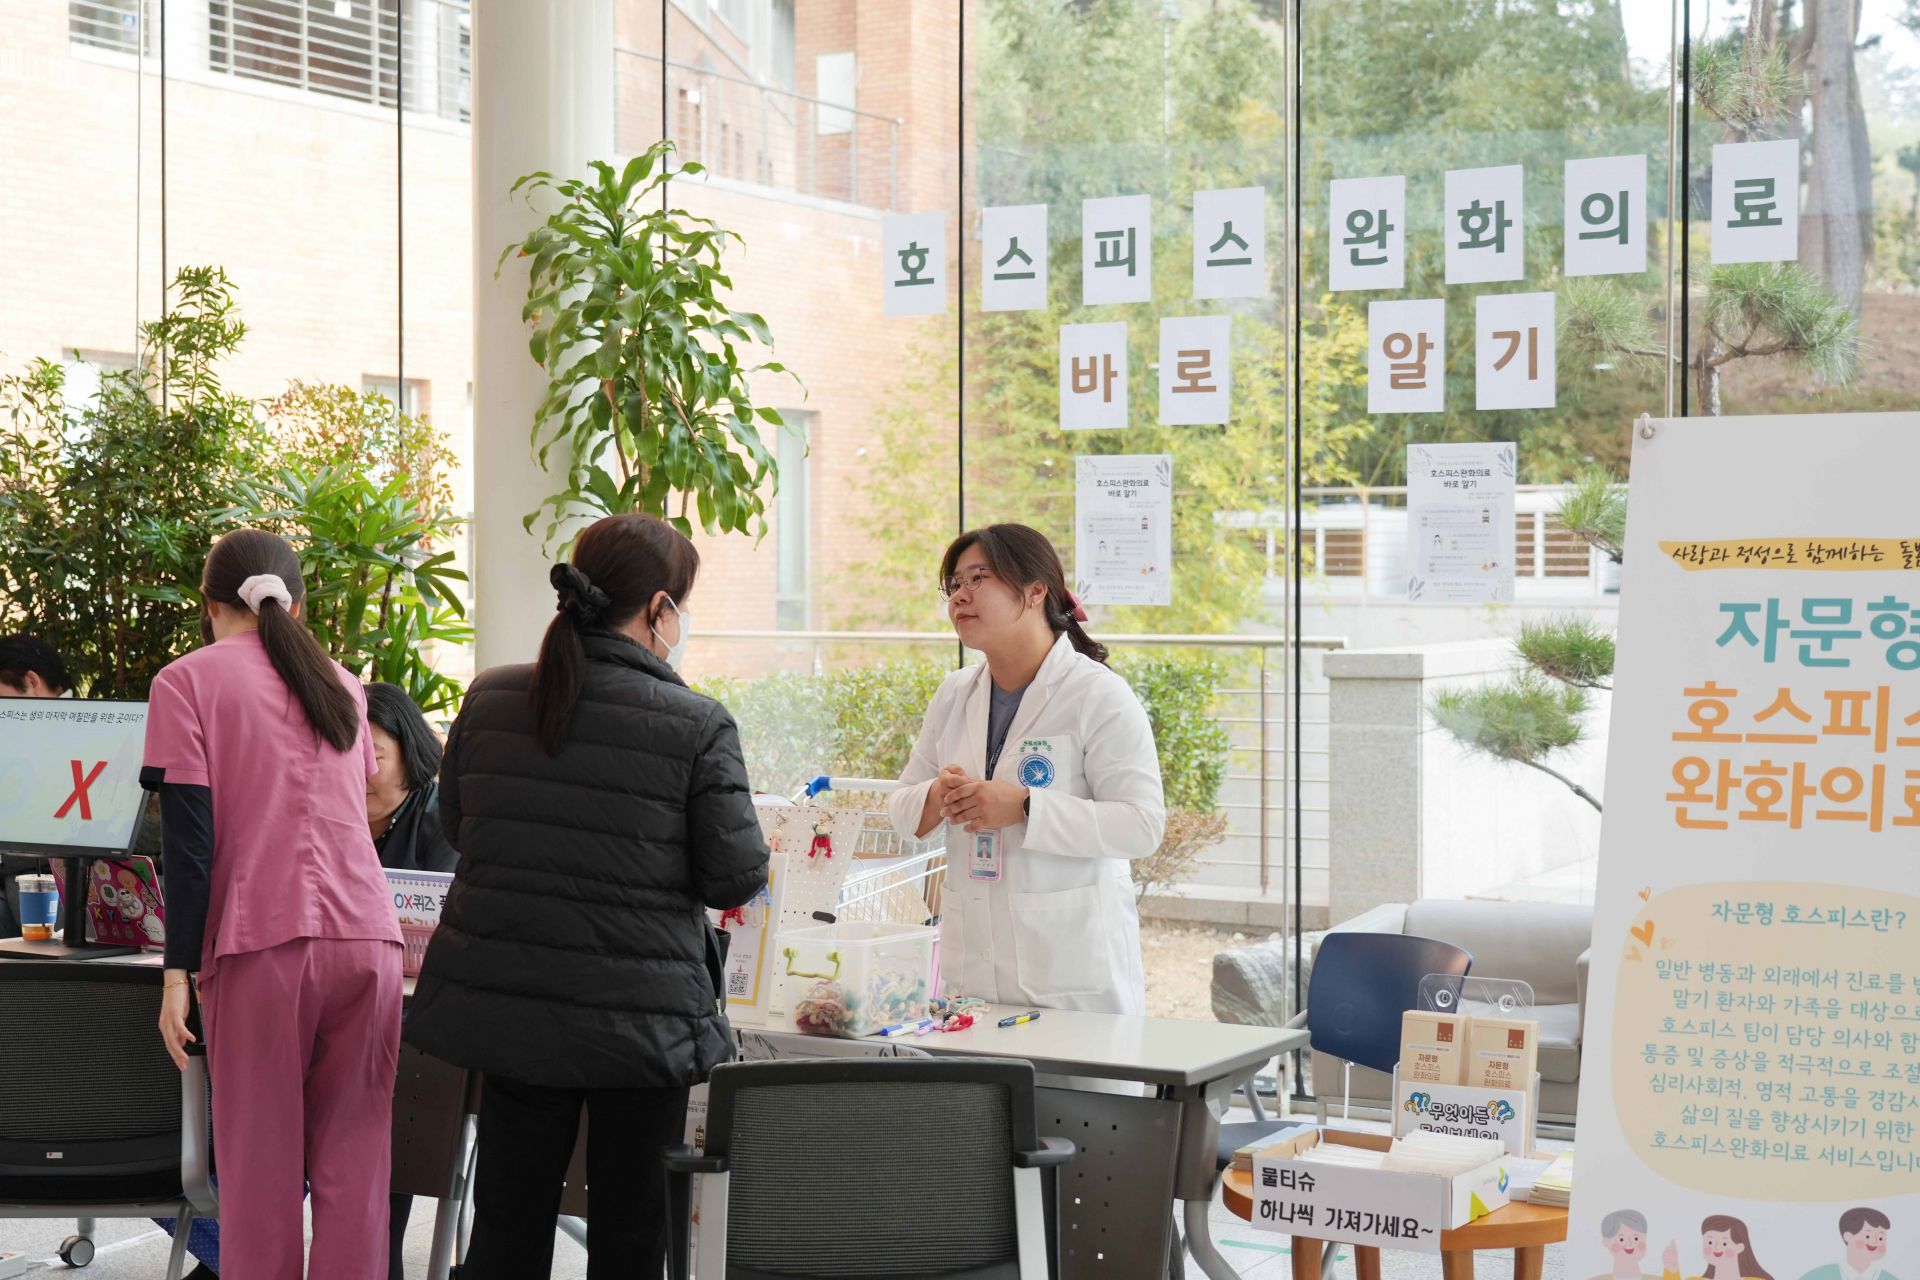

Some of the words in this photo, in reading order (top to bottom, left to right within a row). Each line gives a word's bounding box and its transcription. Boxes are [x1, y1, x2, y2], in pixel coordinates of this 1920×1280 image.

[1672, 544, 1730, 565] 사랑과
[1736, 543, 1799, 565] 정성으로
[1805, 542, 1885, 564] 함께하는
[45, 711, 68, 722] 마지막
[100, 712, 115, 724] 위한
[116, 712, 145, 724] 곳이다?
[53, 759, 108, 820] X
[394, 893, 435, 912] OX퀴즈
[1711, 900, 1774, 926] 자문형
[1780, 904, 1907, 932] 호스피스란?
[1655, 958, 1692, 981] 일반
[1698, 960, 1756, 985] 병동과
[1762, 964, 1838, 991] 외래에서
[1845, 970, 1905, 995] 진료를
[1672, 987, 1709, 1010] 말기
[1715, 990, 1777, 1015] 환자와
[1783, 995, 1843, 1020] 가족을
[1658, 1016, 1737, 1039] 호스피스
[1743, 1021, 1779, 1044] 팀이
[1786, 1024, 1825, 1047] 담당
[1831, 1028, 1893, 1053] 의사와
[1418, 1053, 1438, 1063] 자문형
[1641, 1043, 1681, 1066] 통증
[1687, 1045, 1703, 1068] 및
[1710, 1048, 1771, 1073] 증상을
[1777, 1052, 1876, 1078] 적극적으로
[1755, 1079, 1793, 1104] 영적
[1799, 1085, 1861, 1109] 고통을
[1428, 1102, 1490, 1126] 무엇이든
[1680, 1103, 1719, 1127] 삶의
[1726, 1106, 1764, 1131] 질을
[1770, 1109, 1866, 1139] 향상시키기
[1873, 1117, 1915, 1144] 위한
[1649, 1130, 1811, 1163] 호스피스완화의료
[1261, 1166, 1316, 1192] 물티슈
[1260, 1199, 1315, 1226] 하나씩
[1324, 1207, 1434, 1239] 가져가세요~
